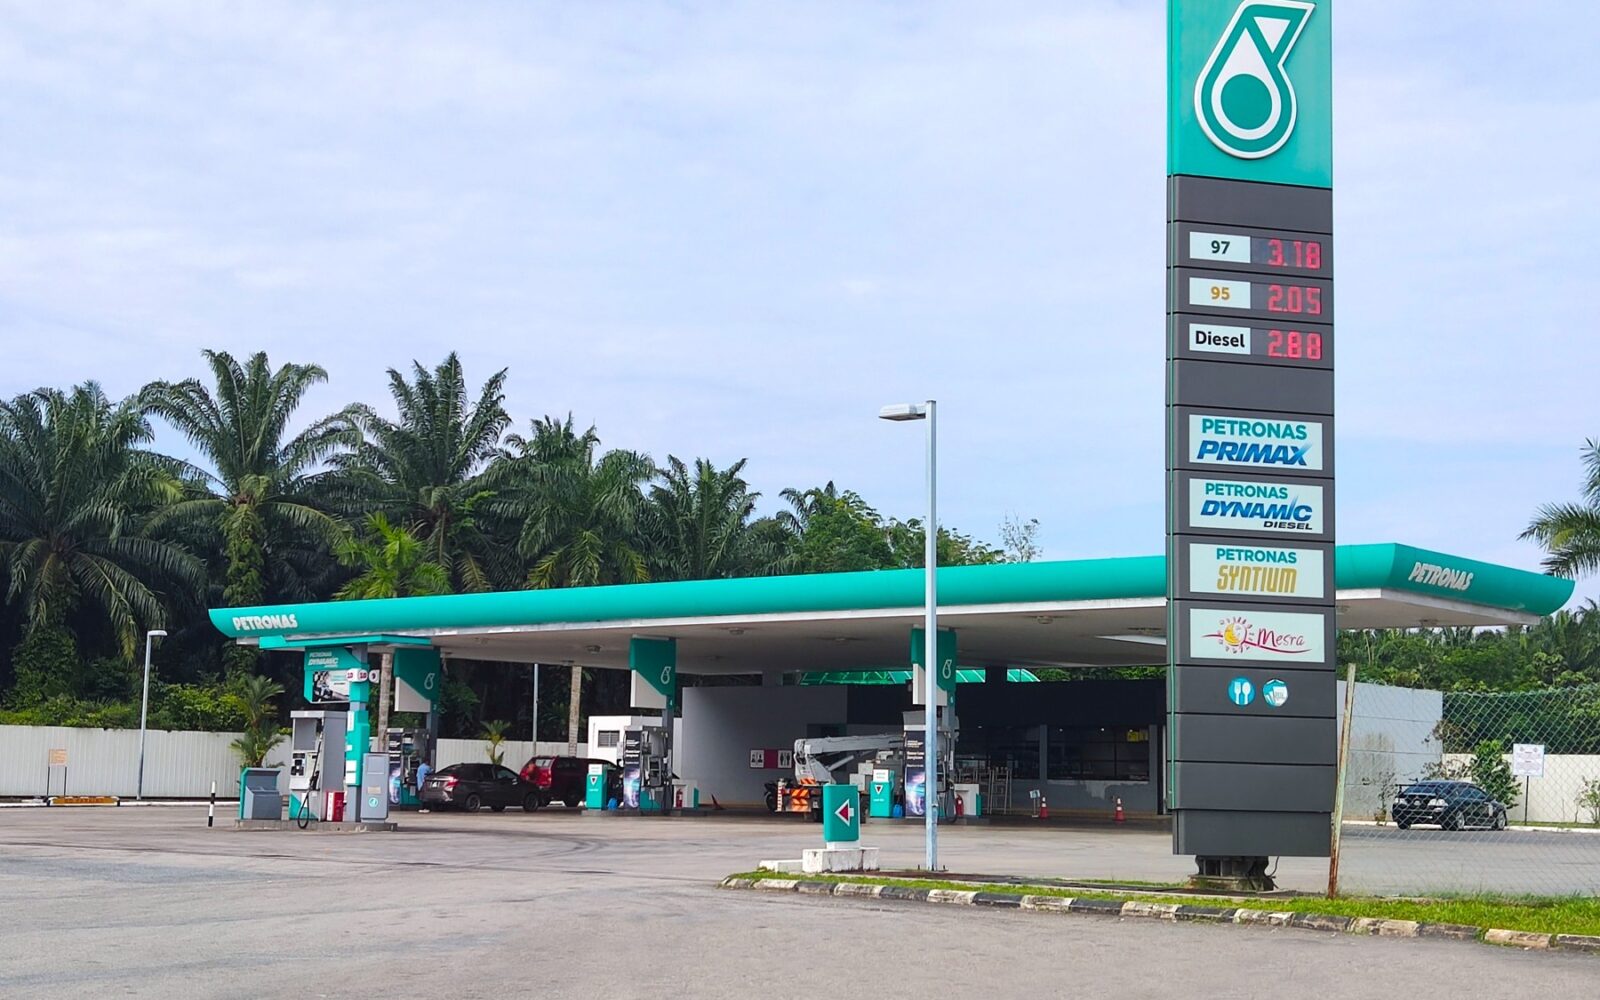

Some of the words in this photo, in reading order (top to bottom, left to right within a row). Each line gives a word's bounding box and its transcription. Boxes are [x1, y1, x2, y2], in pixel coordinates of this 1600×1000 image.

[1211, 240, 1231, 254] 97
[1267, 238, 1321, 270] 3.18
[1211, 286, 1230, 300] 95
[1267, 284, 1321, 315] 2.05
[1195, 331, 1245, 348] Diesel
[1267, 329, 1322, 360] 2.88
[1202, 418, 1307, 440] PETRONAS
[1196, 440, 1312, 466] PRIMAX
[1205, 483, 1288, 499] PETRONAS
[1200, 497, 1313, 521] DYNAMIC
[1263, 520, 1313, 530] DIESEL
[1216, 547, 1297, 563] PETRONAS
[1216, 564, 1297, 593] SYNTIUM
[1408, 561, 1474, 590] PETRONAS
[232, 613, 298, 631] PETRONAS
[1257, 628, 1305, 647] Mesra
